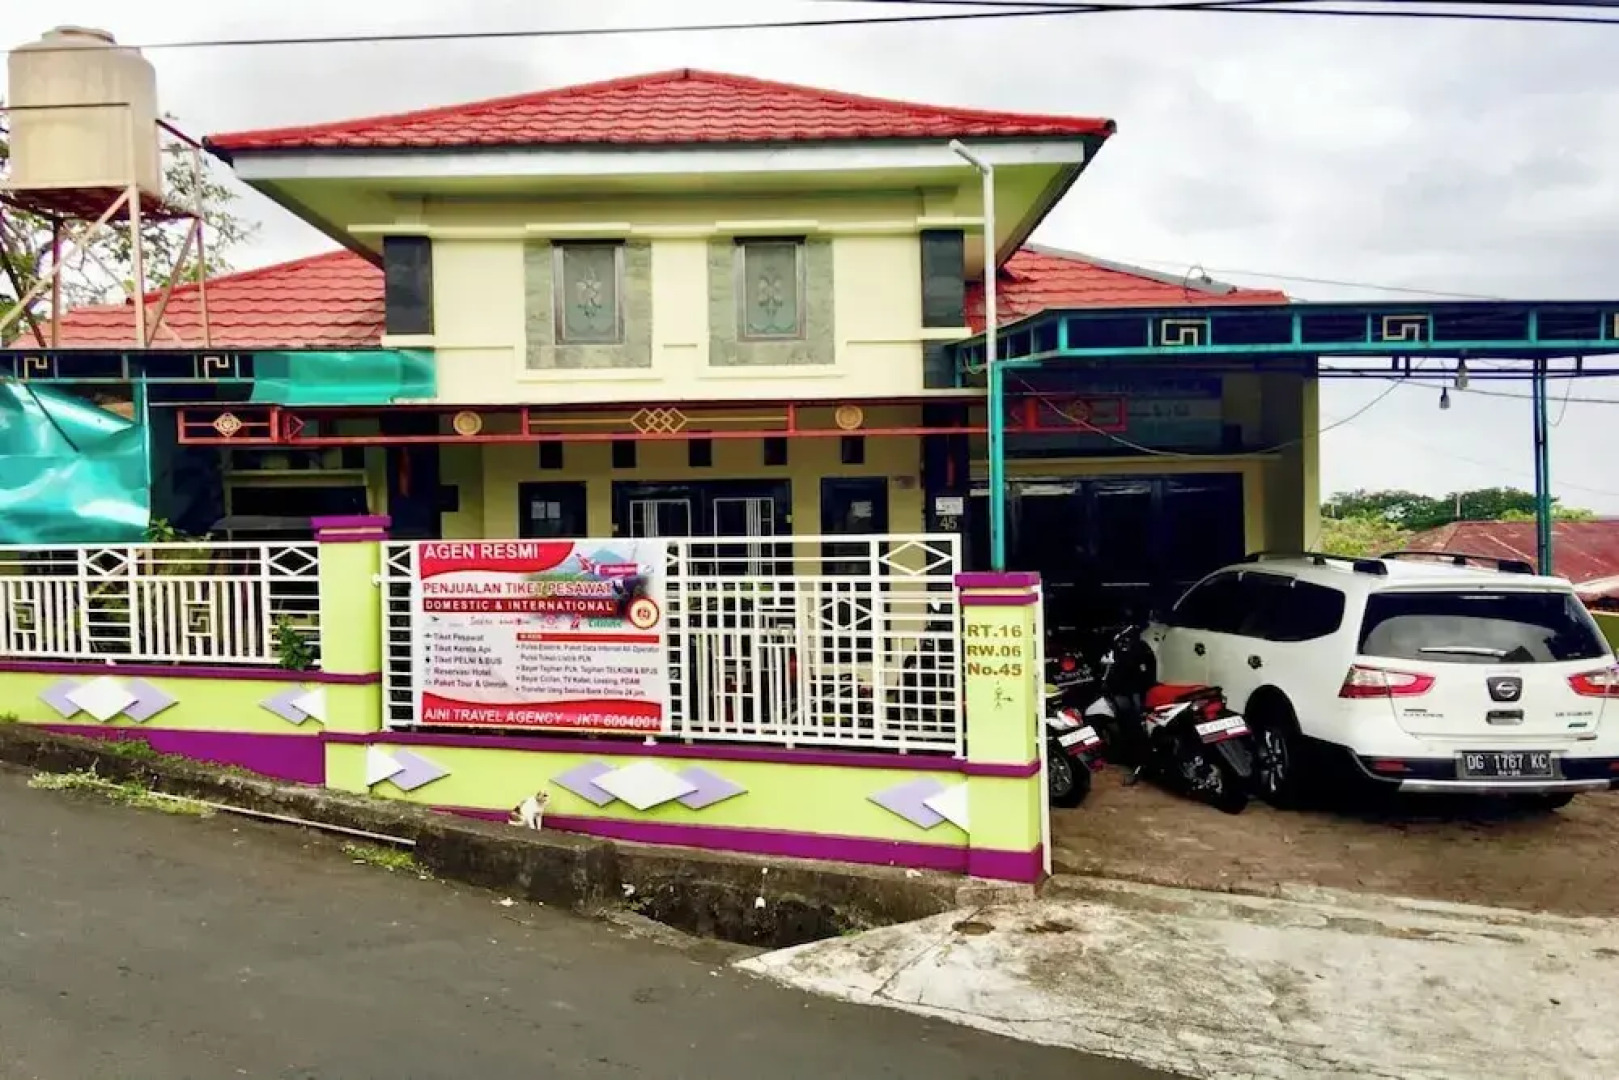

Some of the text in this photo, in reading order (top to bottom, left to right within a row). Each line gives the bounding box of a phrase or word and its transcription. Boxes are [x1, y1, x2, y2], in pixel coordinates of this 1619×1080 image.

[939, 516, 958, 530] 45
[424, 544, 539, 559] AGEN RESMI
[423, 582, 612, 597] PENJUALAN TIKET PESAWAT
[425, 600, 613, 611] DOMESTIC & INTERNATIONAL
[967, 624, 1023, 638] RT.16
[967, 645, 1022, 657] RW.06
[967, 662, 1023, 676] No.45
[424, 708, 450, 720] AINI
[453, 708, 503, 721] TRAVEL
[506, 711, 564, 724] AGENCY
[574, 713, 601, 727] JKT
[1467, 752, 1547, 770] DG 1767 KC
